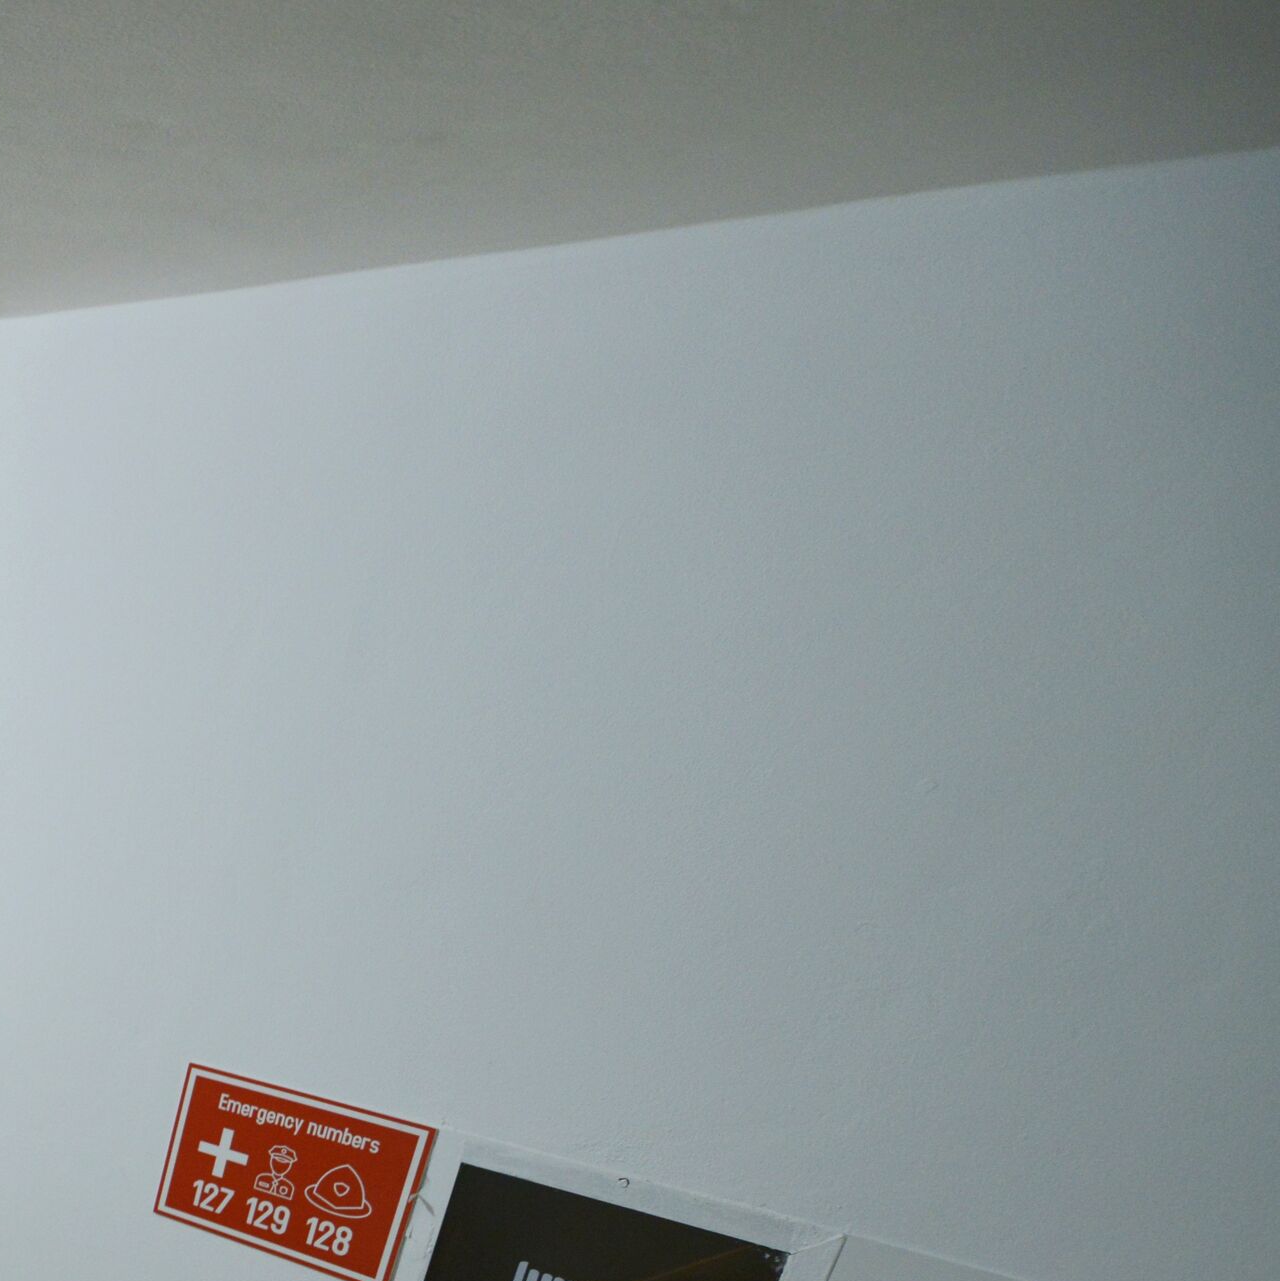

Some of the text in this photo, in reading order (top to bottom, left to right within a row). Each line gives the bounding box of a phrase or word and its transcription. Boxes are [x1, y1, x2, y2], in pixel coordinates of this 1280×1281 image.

[218, 1092, 381, 1154] Emergency numbers
[192, 1179, 354, 1257] 127 129 128
